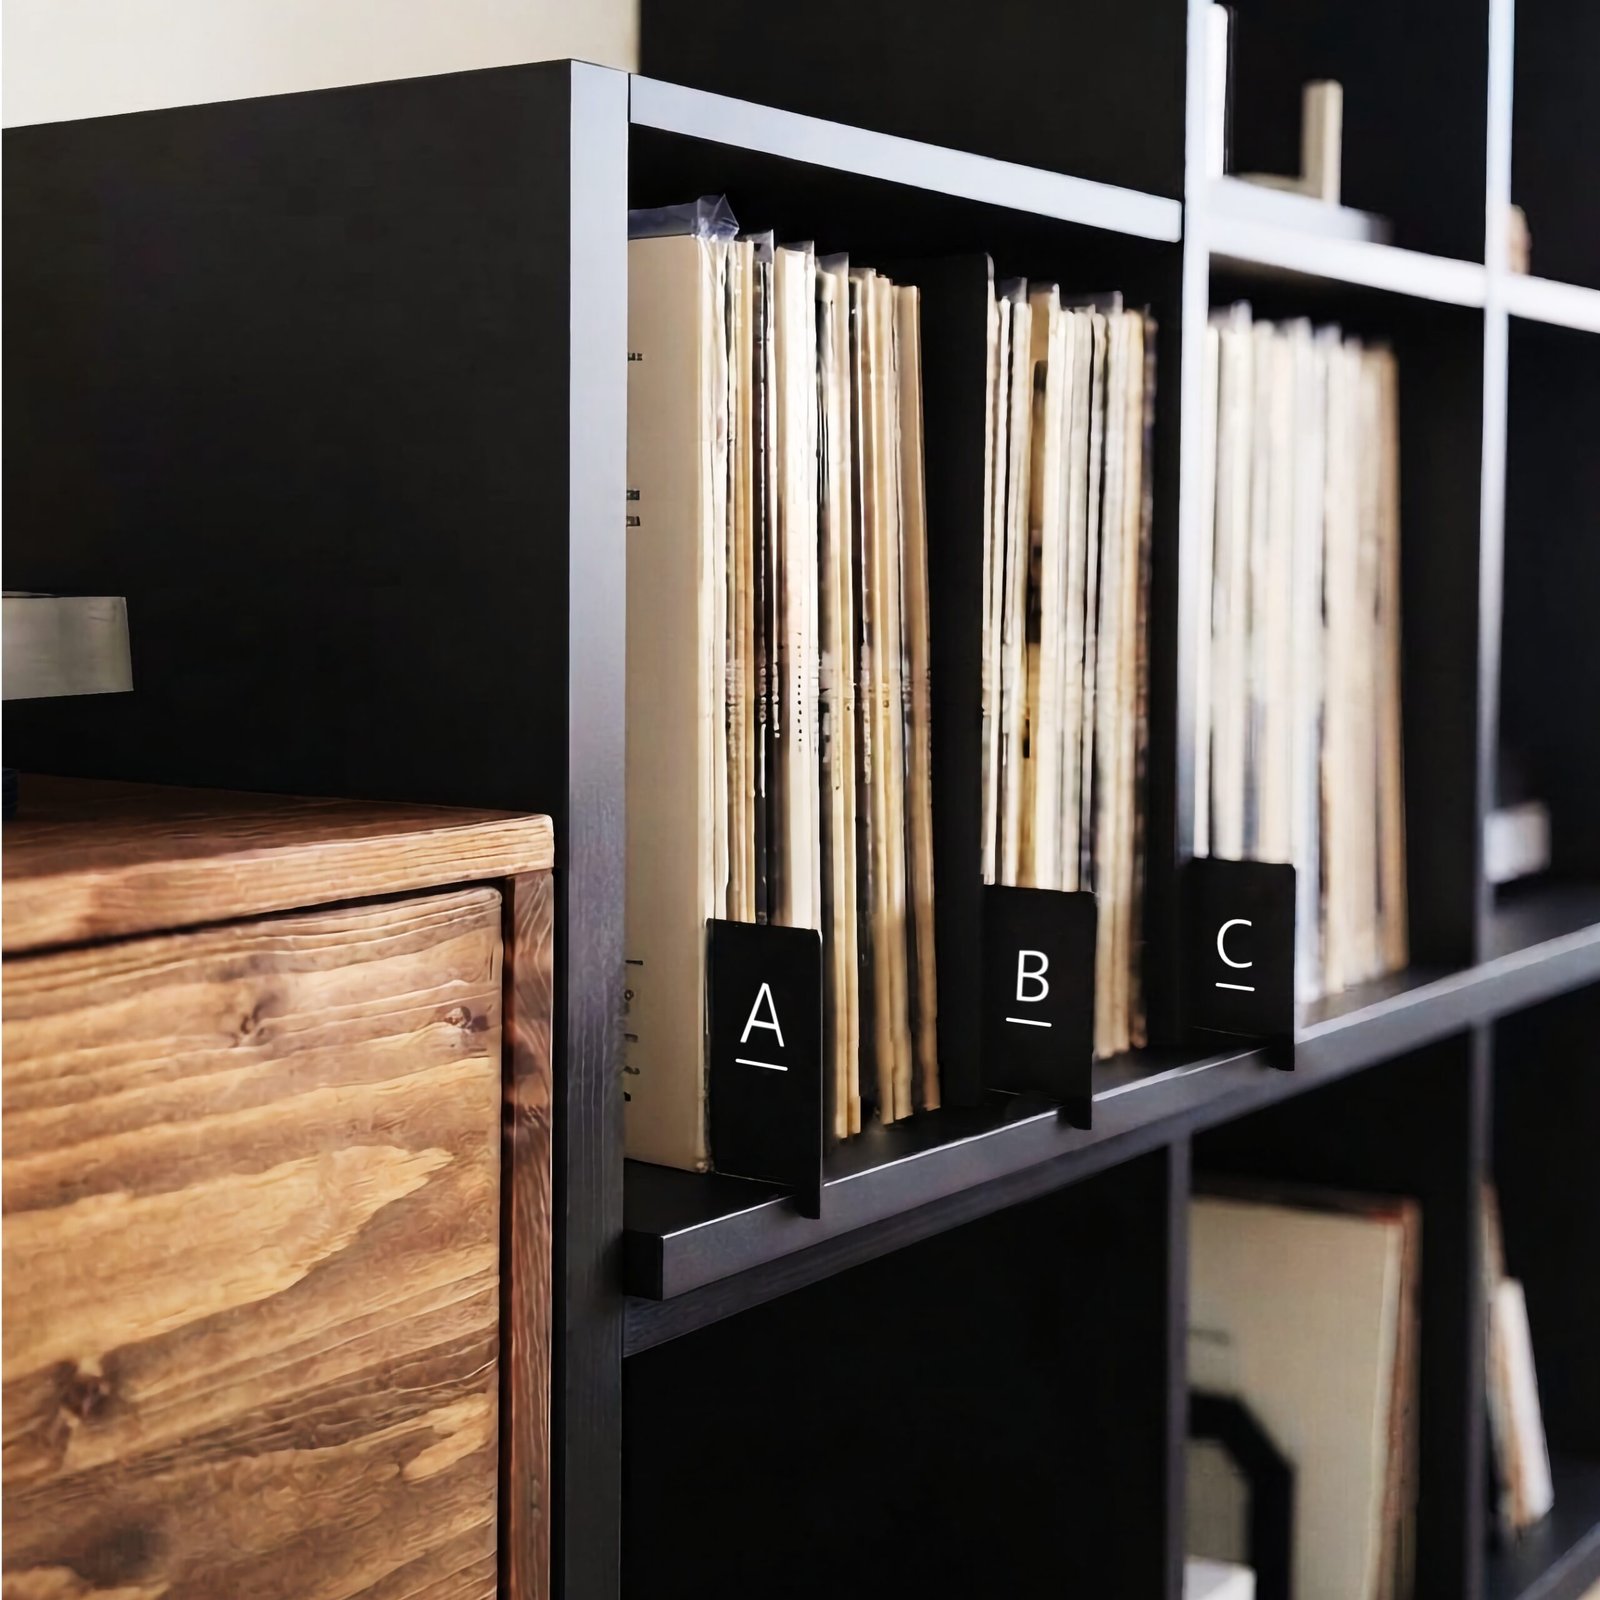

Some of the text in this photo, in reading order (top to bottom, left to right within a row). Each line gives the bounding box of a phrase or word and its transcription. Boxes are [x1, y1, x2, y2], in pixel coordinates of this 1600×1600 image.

[1216, 918, 1253, 969] C
[1016, 949, 1050, 1003] B
[739, 982, 785, 1047] A
